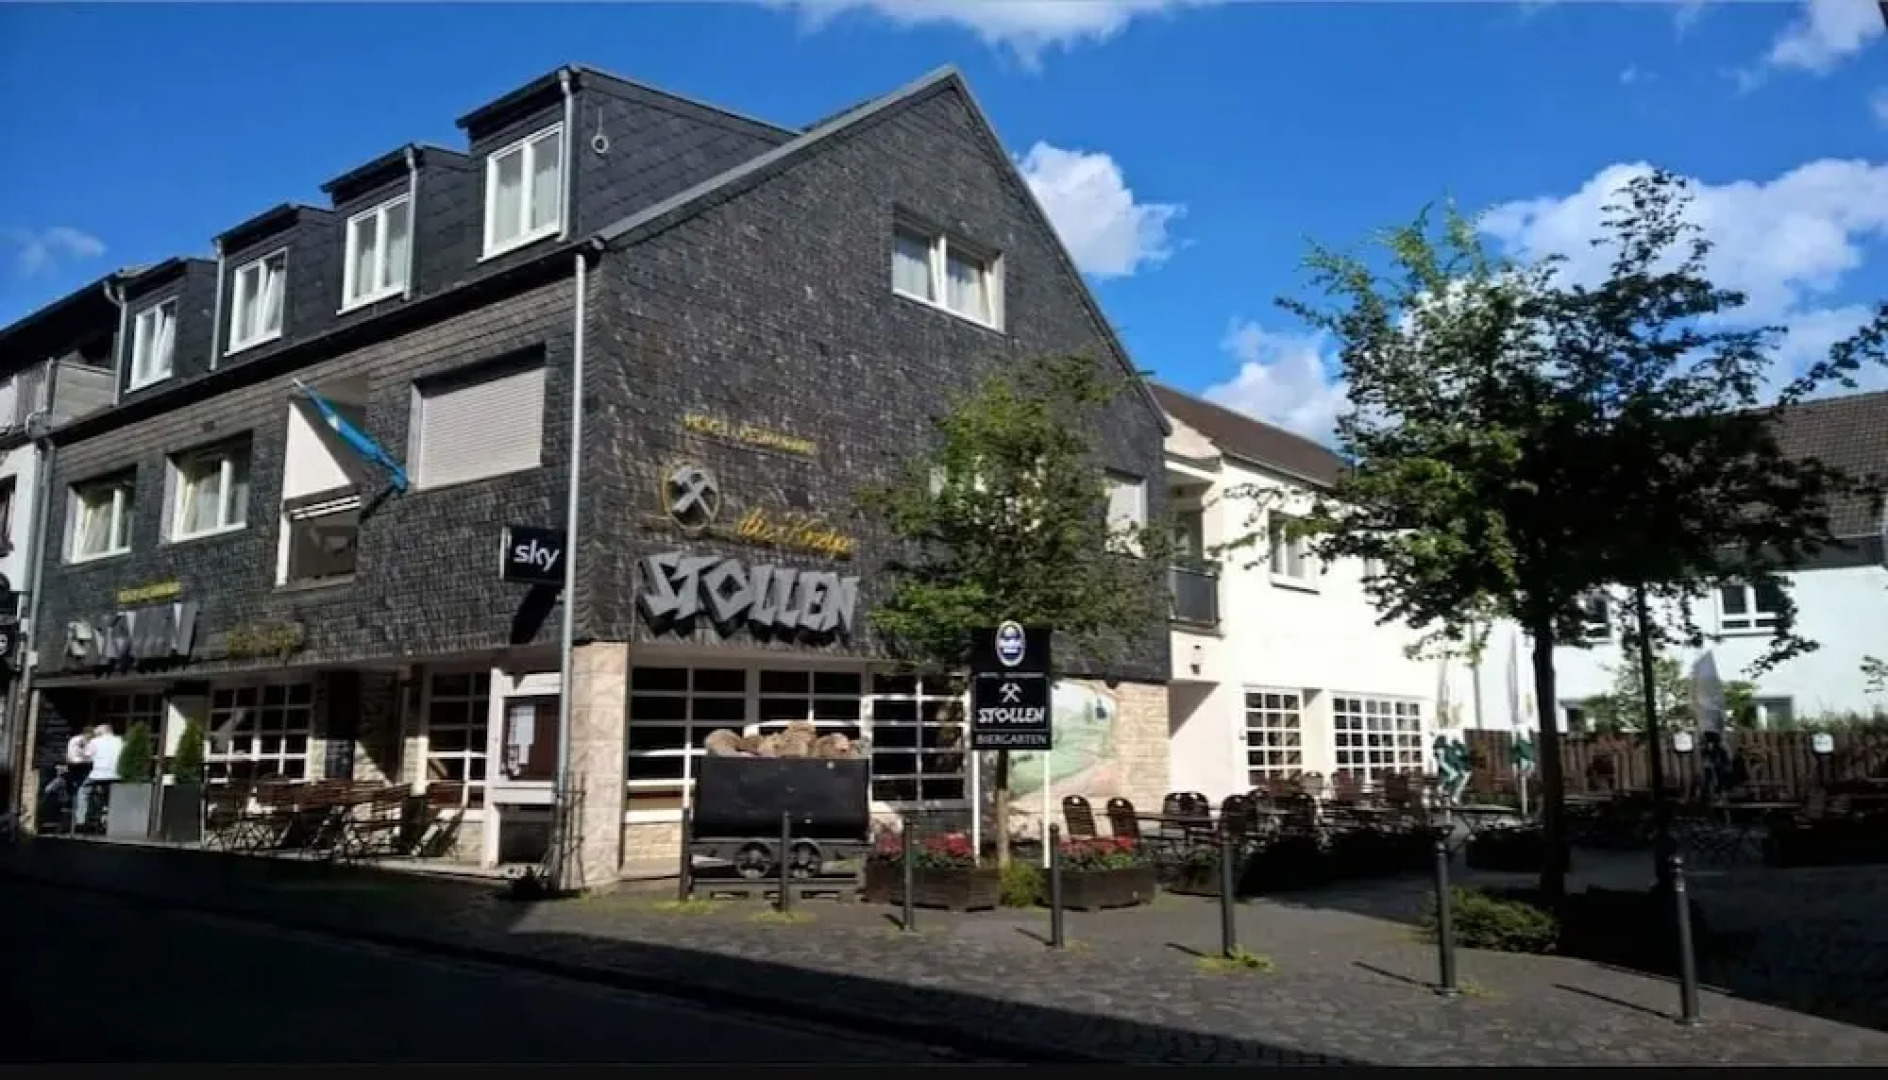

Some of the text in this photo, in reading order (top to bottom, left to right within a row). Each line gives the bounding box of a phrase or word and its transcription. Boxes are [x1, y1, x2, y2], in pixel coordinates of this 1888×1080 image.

[513, 538, 560, 572] sky
[638, 551, 861, 640] STOLLEN
[977, 706, 1045, 723] STOLLEN
[977, 733, 1047, 745] BIERGARTEN
